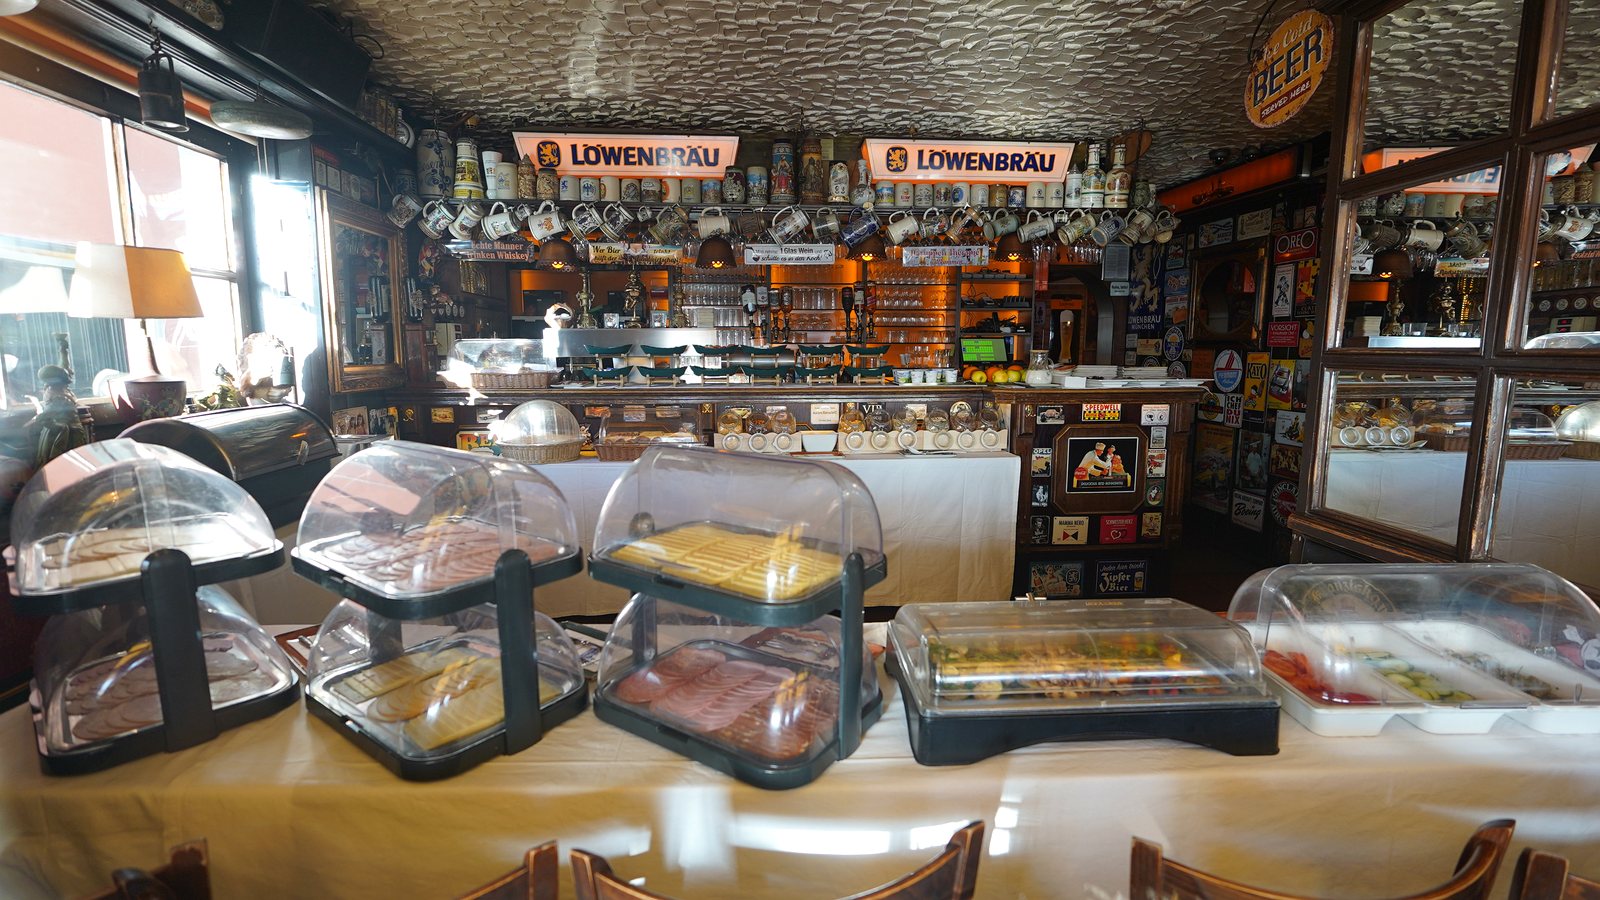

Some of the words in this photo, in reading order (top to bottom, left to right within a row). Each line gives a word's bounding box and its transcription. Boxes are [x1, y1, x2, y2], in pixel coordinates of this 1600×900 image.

[1283, 14, 1313, 48] Cold
[1253, 27, 1324, 109] BEER
[1261, 96, 1289, 119] SERVED
[1290, 81, 1311, 99] HERE
[571, 143, 720, 167] LÖWENBRÄU
[917, 149, 1056, 173] LÖWENBRÄU
[606, 245, 621, 254] Bier
[1276, 230, 1316, 254] OREO
[496, 250, 530, 261] Whiskey
[1246, 362, 1267, 380] KAYO
[1226, 402, 1241, 410] CHEF
[1226, 415, 1240, 424] NIX
[1099, 571, 1131, 593] Zipfer
[1108, 583, 1129, 592] Bier
